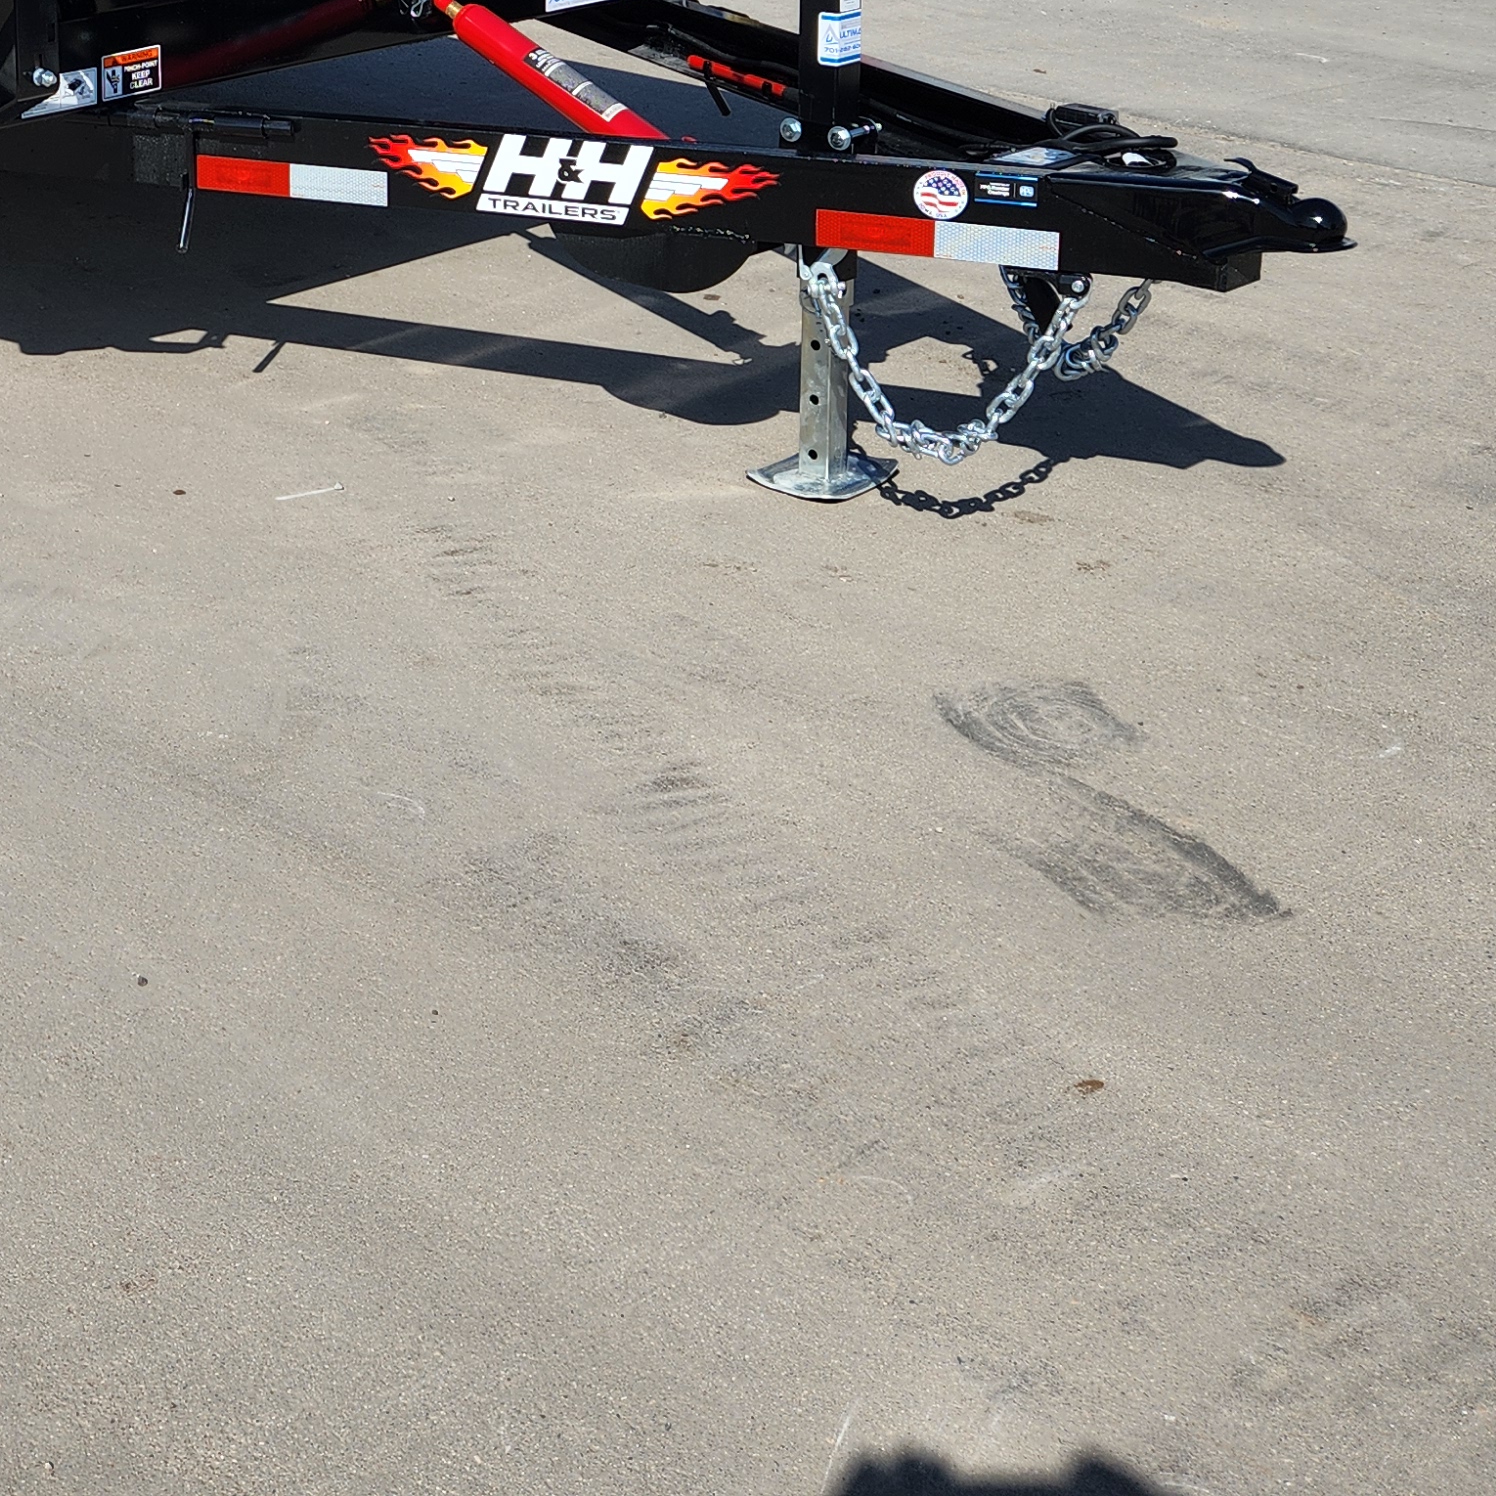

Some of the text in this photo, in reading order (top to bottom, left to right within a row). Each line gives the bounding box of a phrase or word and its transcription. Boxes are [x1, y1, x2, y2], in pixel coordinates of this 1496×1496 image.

[121, 49, 153, 62] WARNING
[132, 69, 150, 81] KEEP
[130, 78, 154, 90] CLEAR
[483, 133, 654, 206] H&H
[488, 197, 617, 221] TRAILERS
